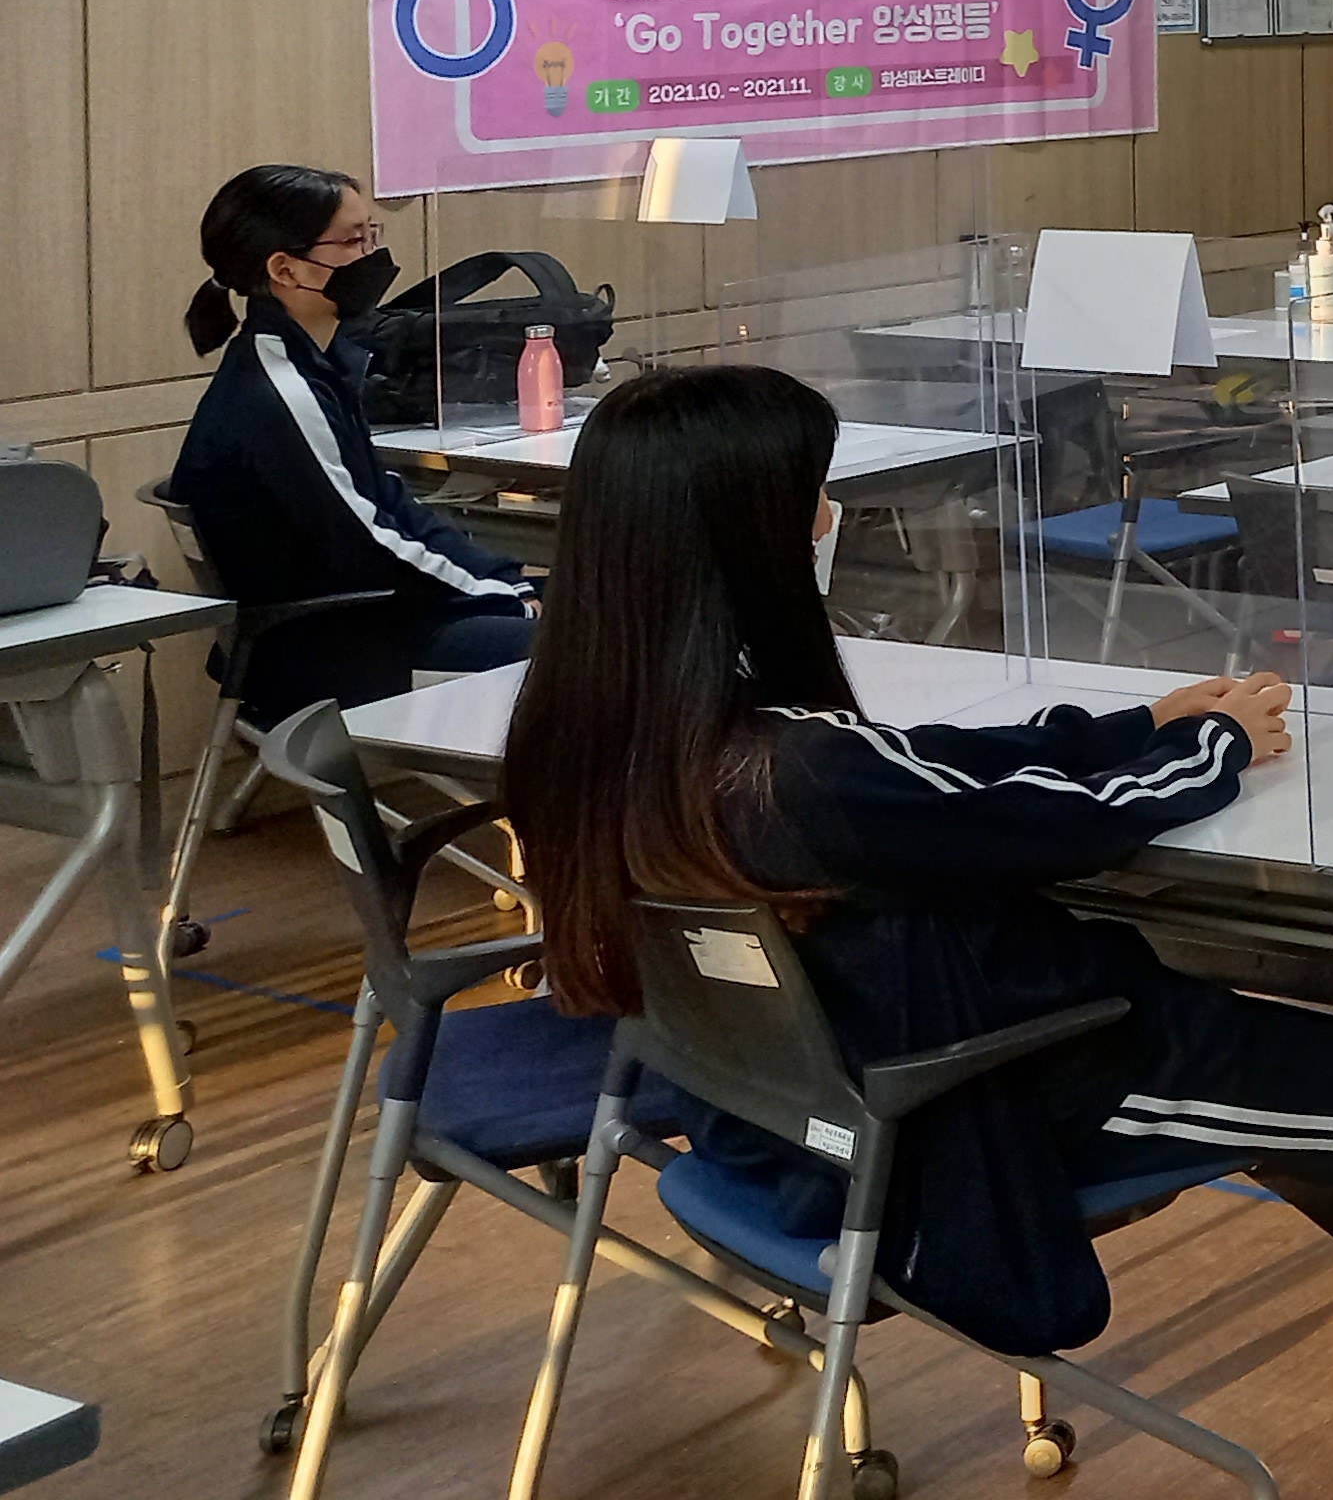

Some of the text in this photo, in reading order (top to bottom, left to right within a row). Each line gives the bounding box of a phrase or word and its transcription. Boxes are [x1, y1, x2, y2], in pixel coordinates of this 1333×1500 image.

[693, 9, 863, 55] Together
[648, 85, 725, 104] 2021.10.
[743, 77, 812, 98] 2021.11.
